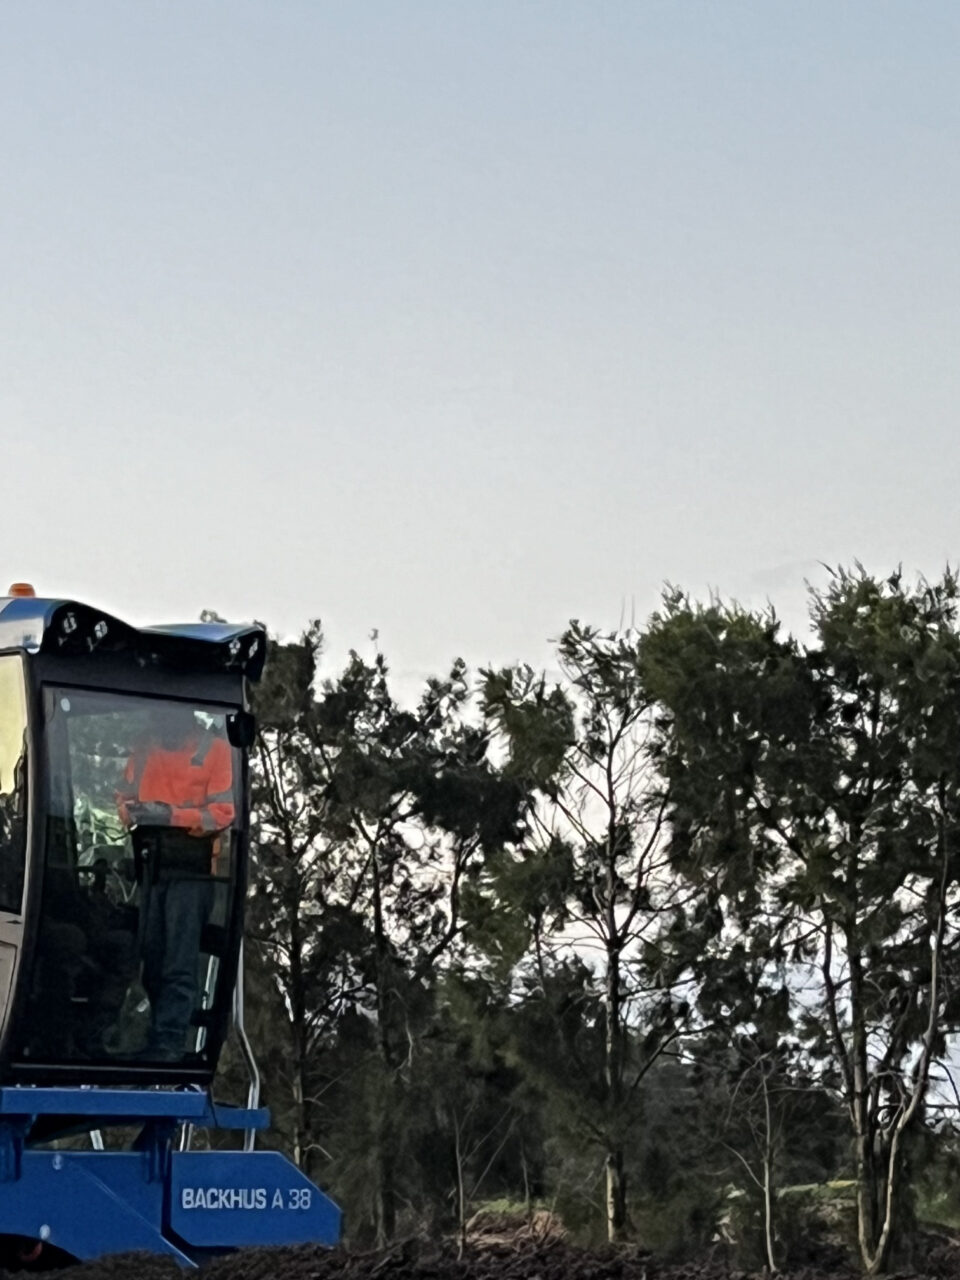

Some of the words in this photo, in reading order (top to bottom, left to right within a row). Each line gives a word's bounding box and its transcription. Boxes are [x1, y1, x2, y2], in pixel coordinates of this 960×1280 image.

[182, 1188, 267, 1210] BACKHUS
[271, 1188, 284, 1210] A
[288, 1188, 312, 1210] 38
